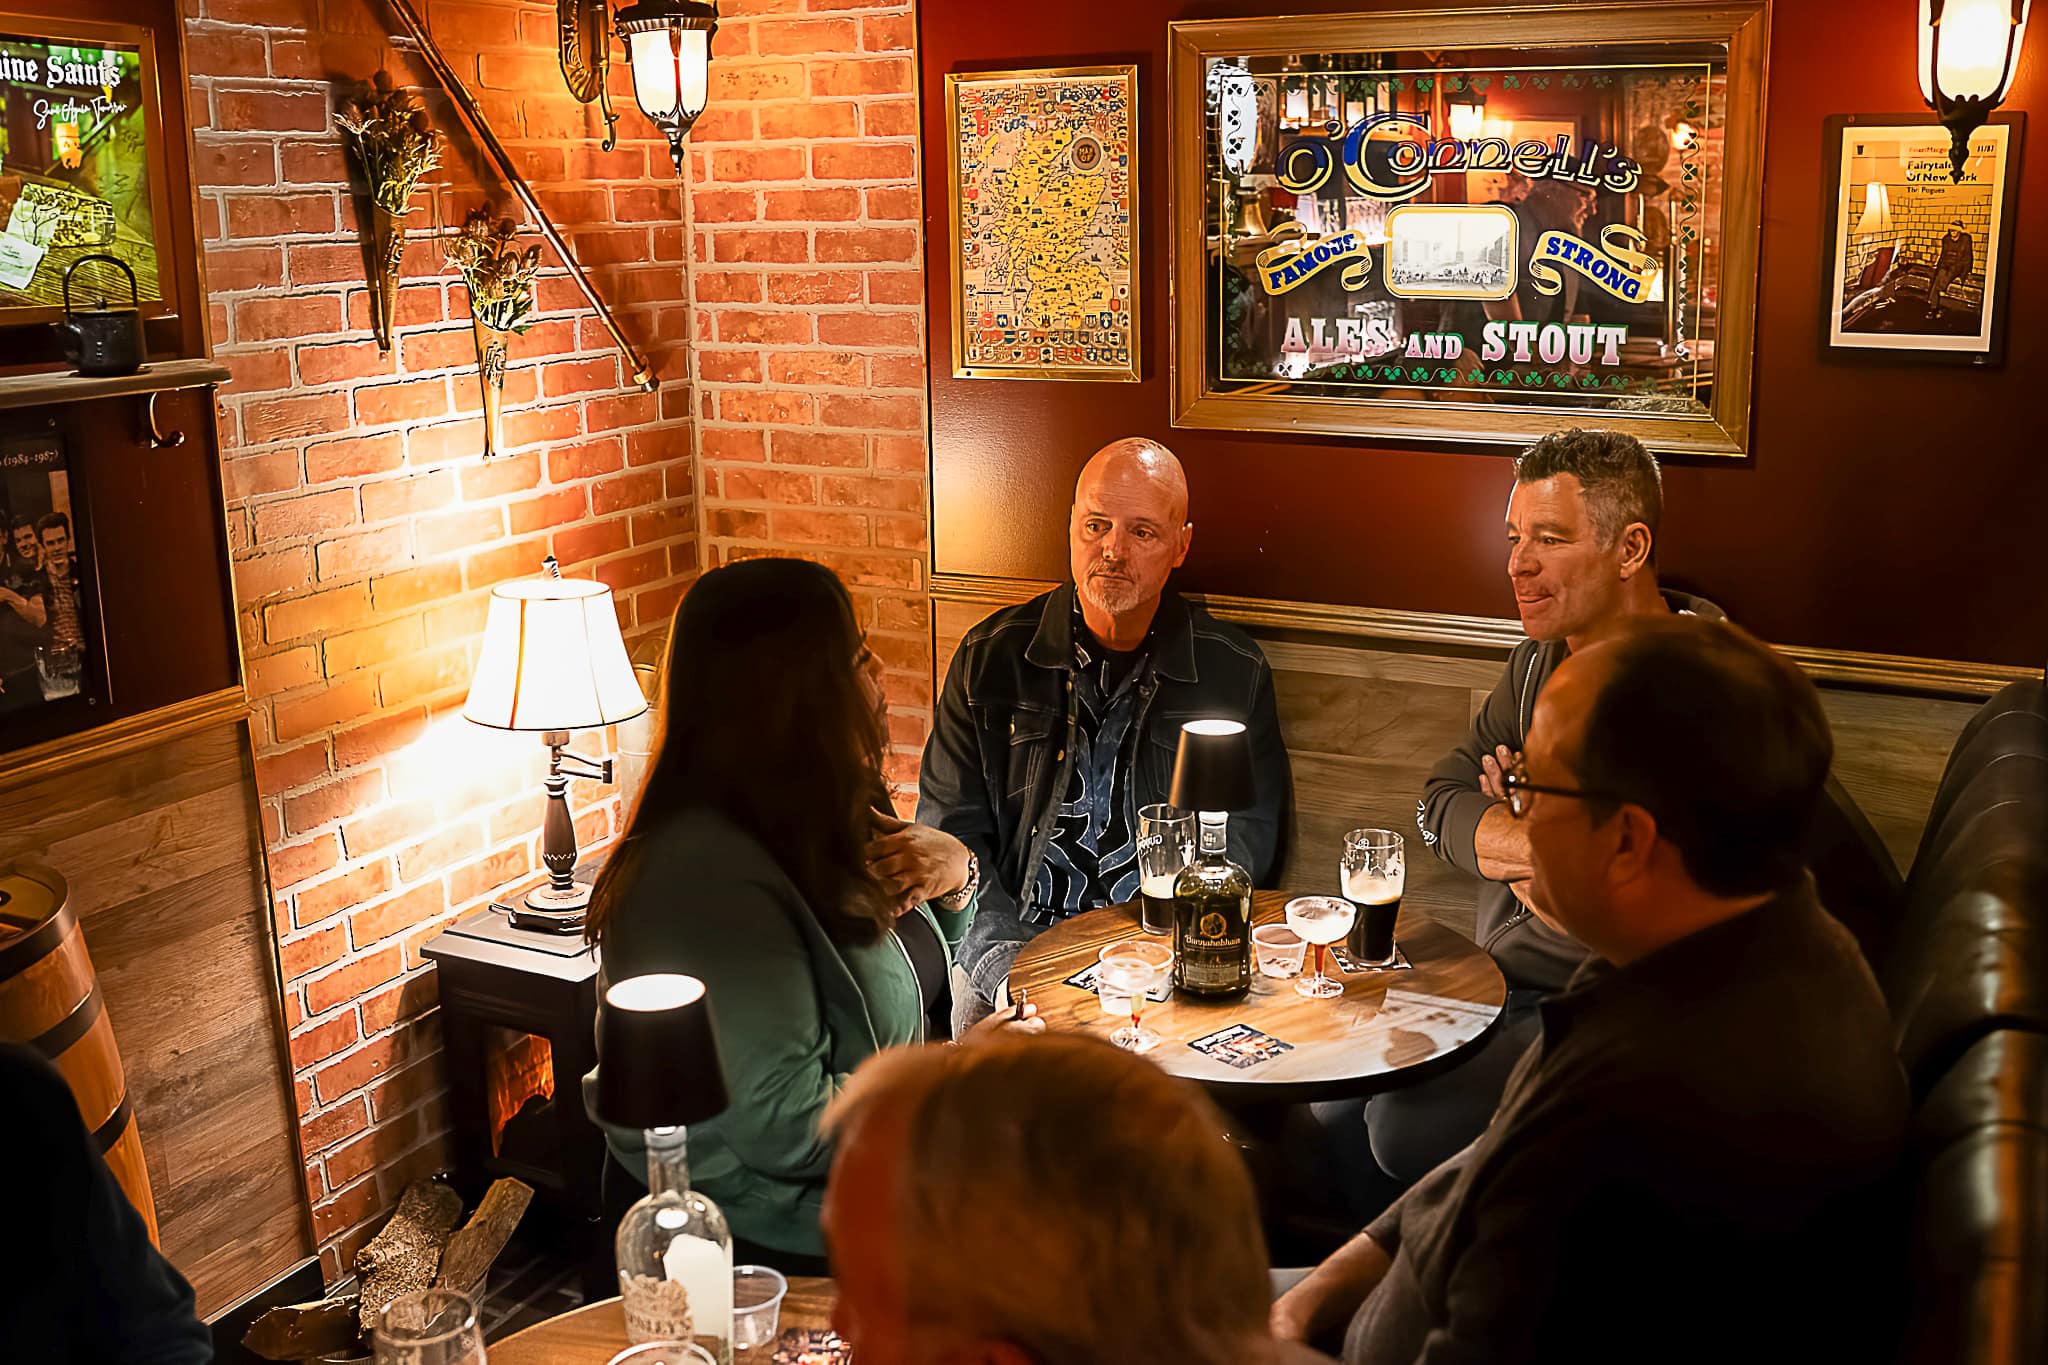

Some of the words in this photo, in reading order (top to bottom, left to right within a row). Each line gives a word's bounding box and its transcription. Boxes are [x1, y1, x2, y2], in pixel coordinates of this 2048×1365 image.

[0, 49, 39, 83] ine
[46, 54, 121, 89] Saints
[1274, 111, 1643, 202] O'Connell's
[1922, 173, 1948, 182] New
[1268, 233, 1359, 290] FAMOUS
[1545, 236, 1642, 300] STRONG
[1281, 316, 1391, 357] ALES
[1404, 331, 1464, 360] AND
[1481, 319, 1628, 367] STOUT
